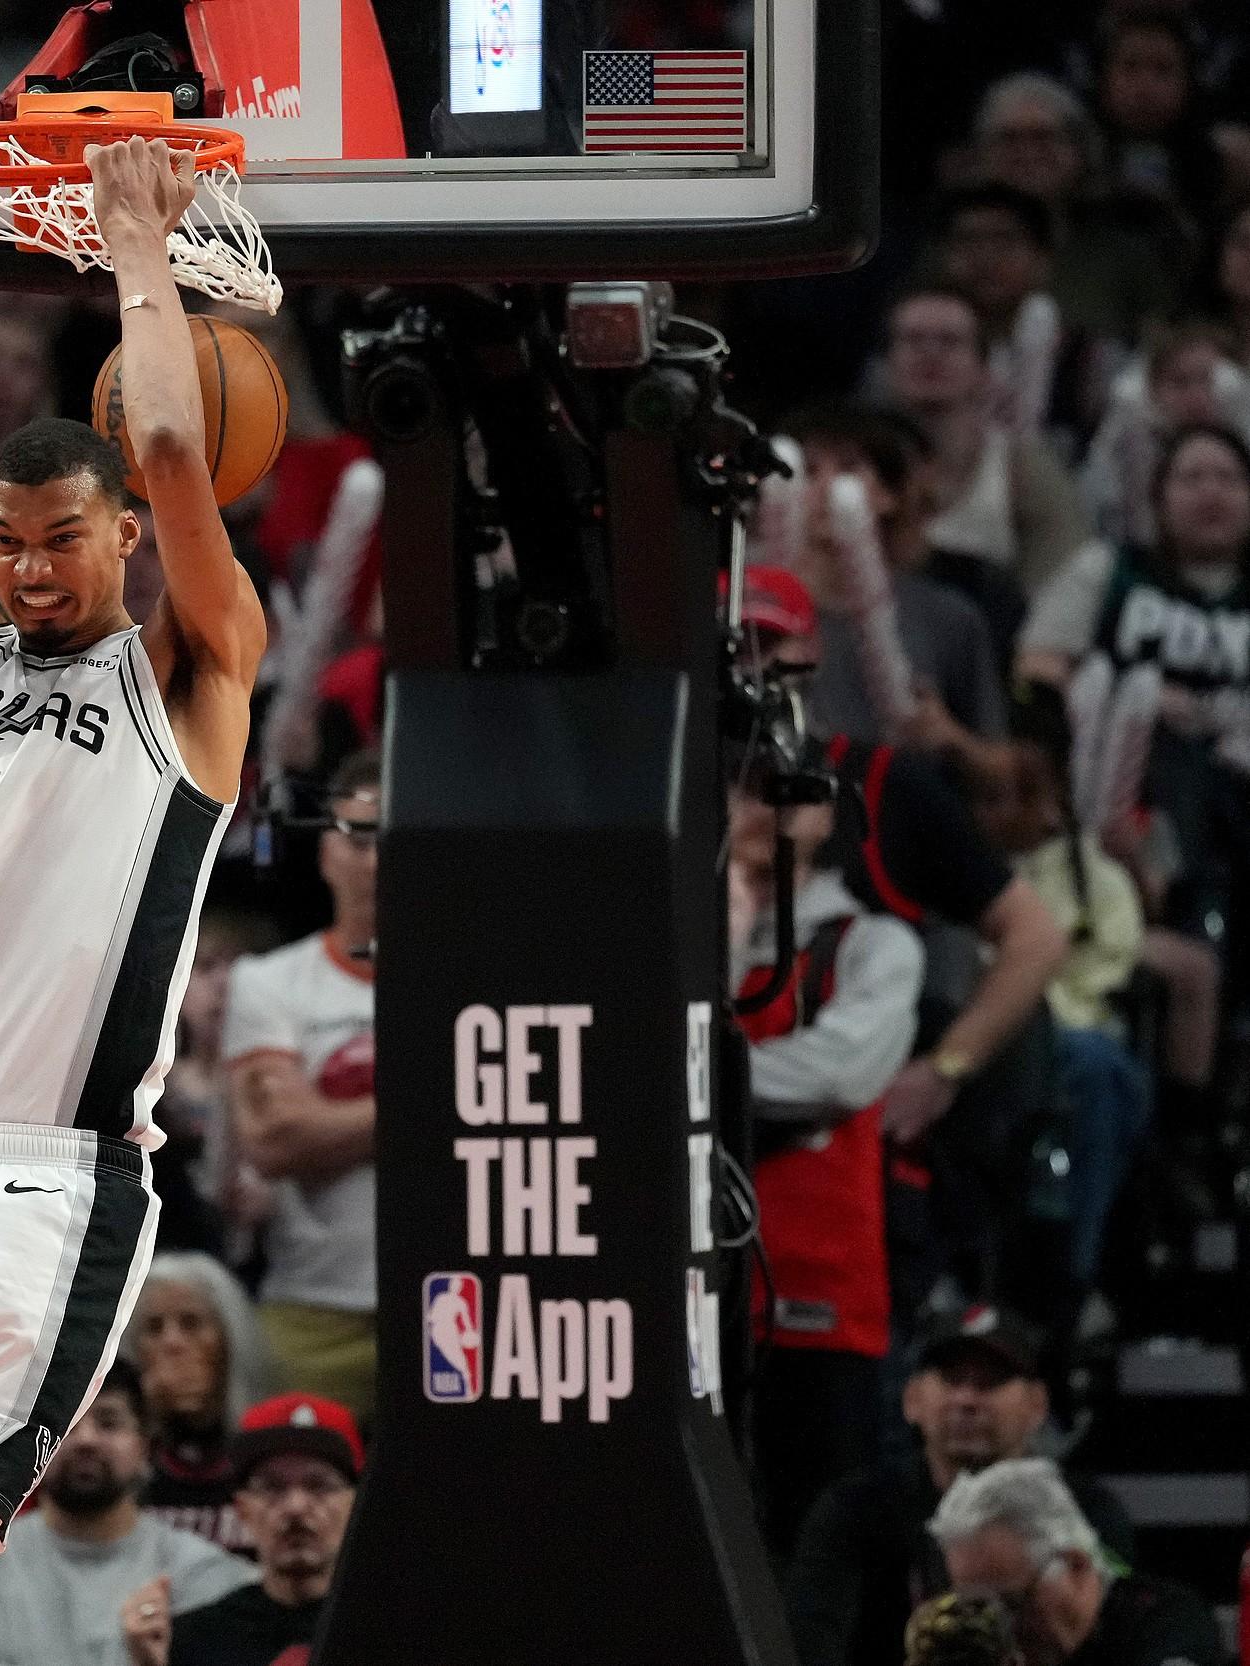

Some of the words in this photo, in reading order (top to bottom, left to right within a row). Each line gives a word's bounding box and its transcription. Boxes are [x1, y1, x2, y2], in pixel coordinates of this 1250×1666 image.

[73, 656, 110, 668] DGER
[454, 1003, 594, 1126] GET
[454, 1136, 598, 1257] THE
[490, 1273, 634, 1423] App
